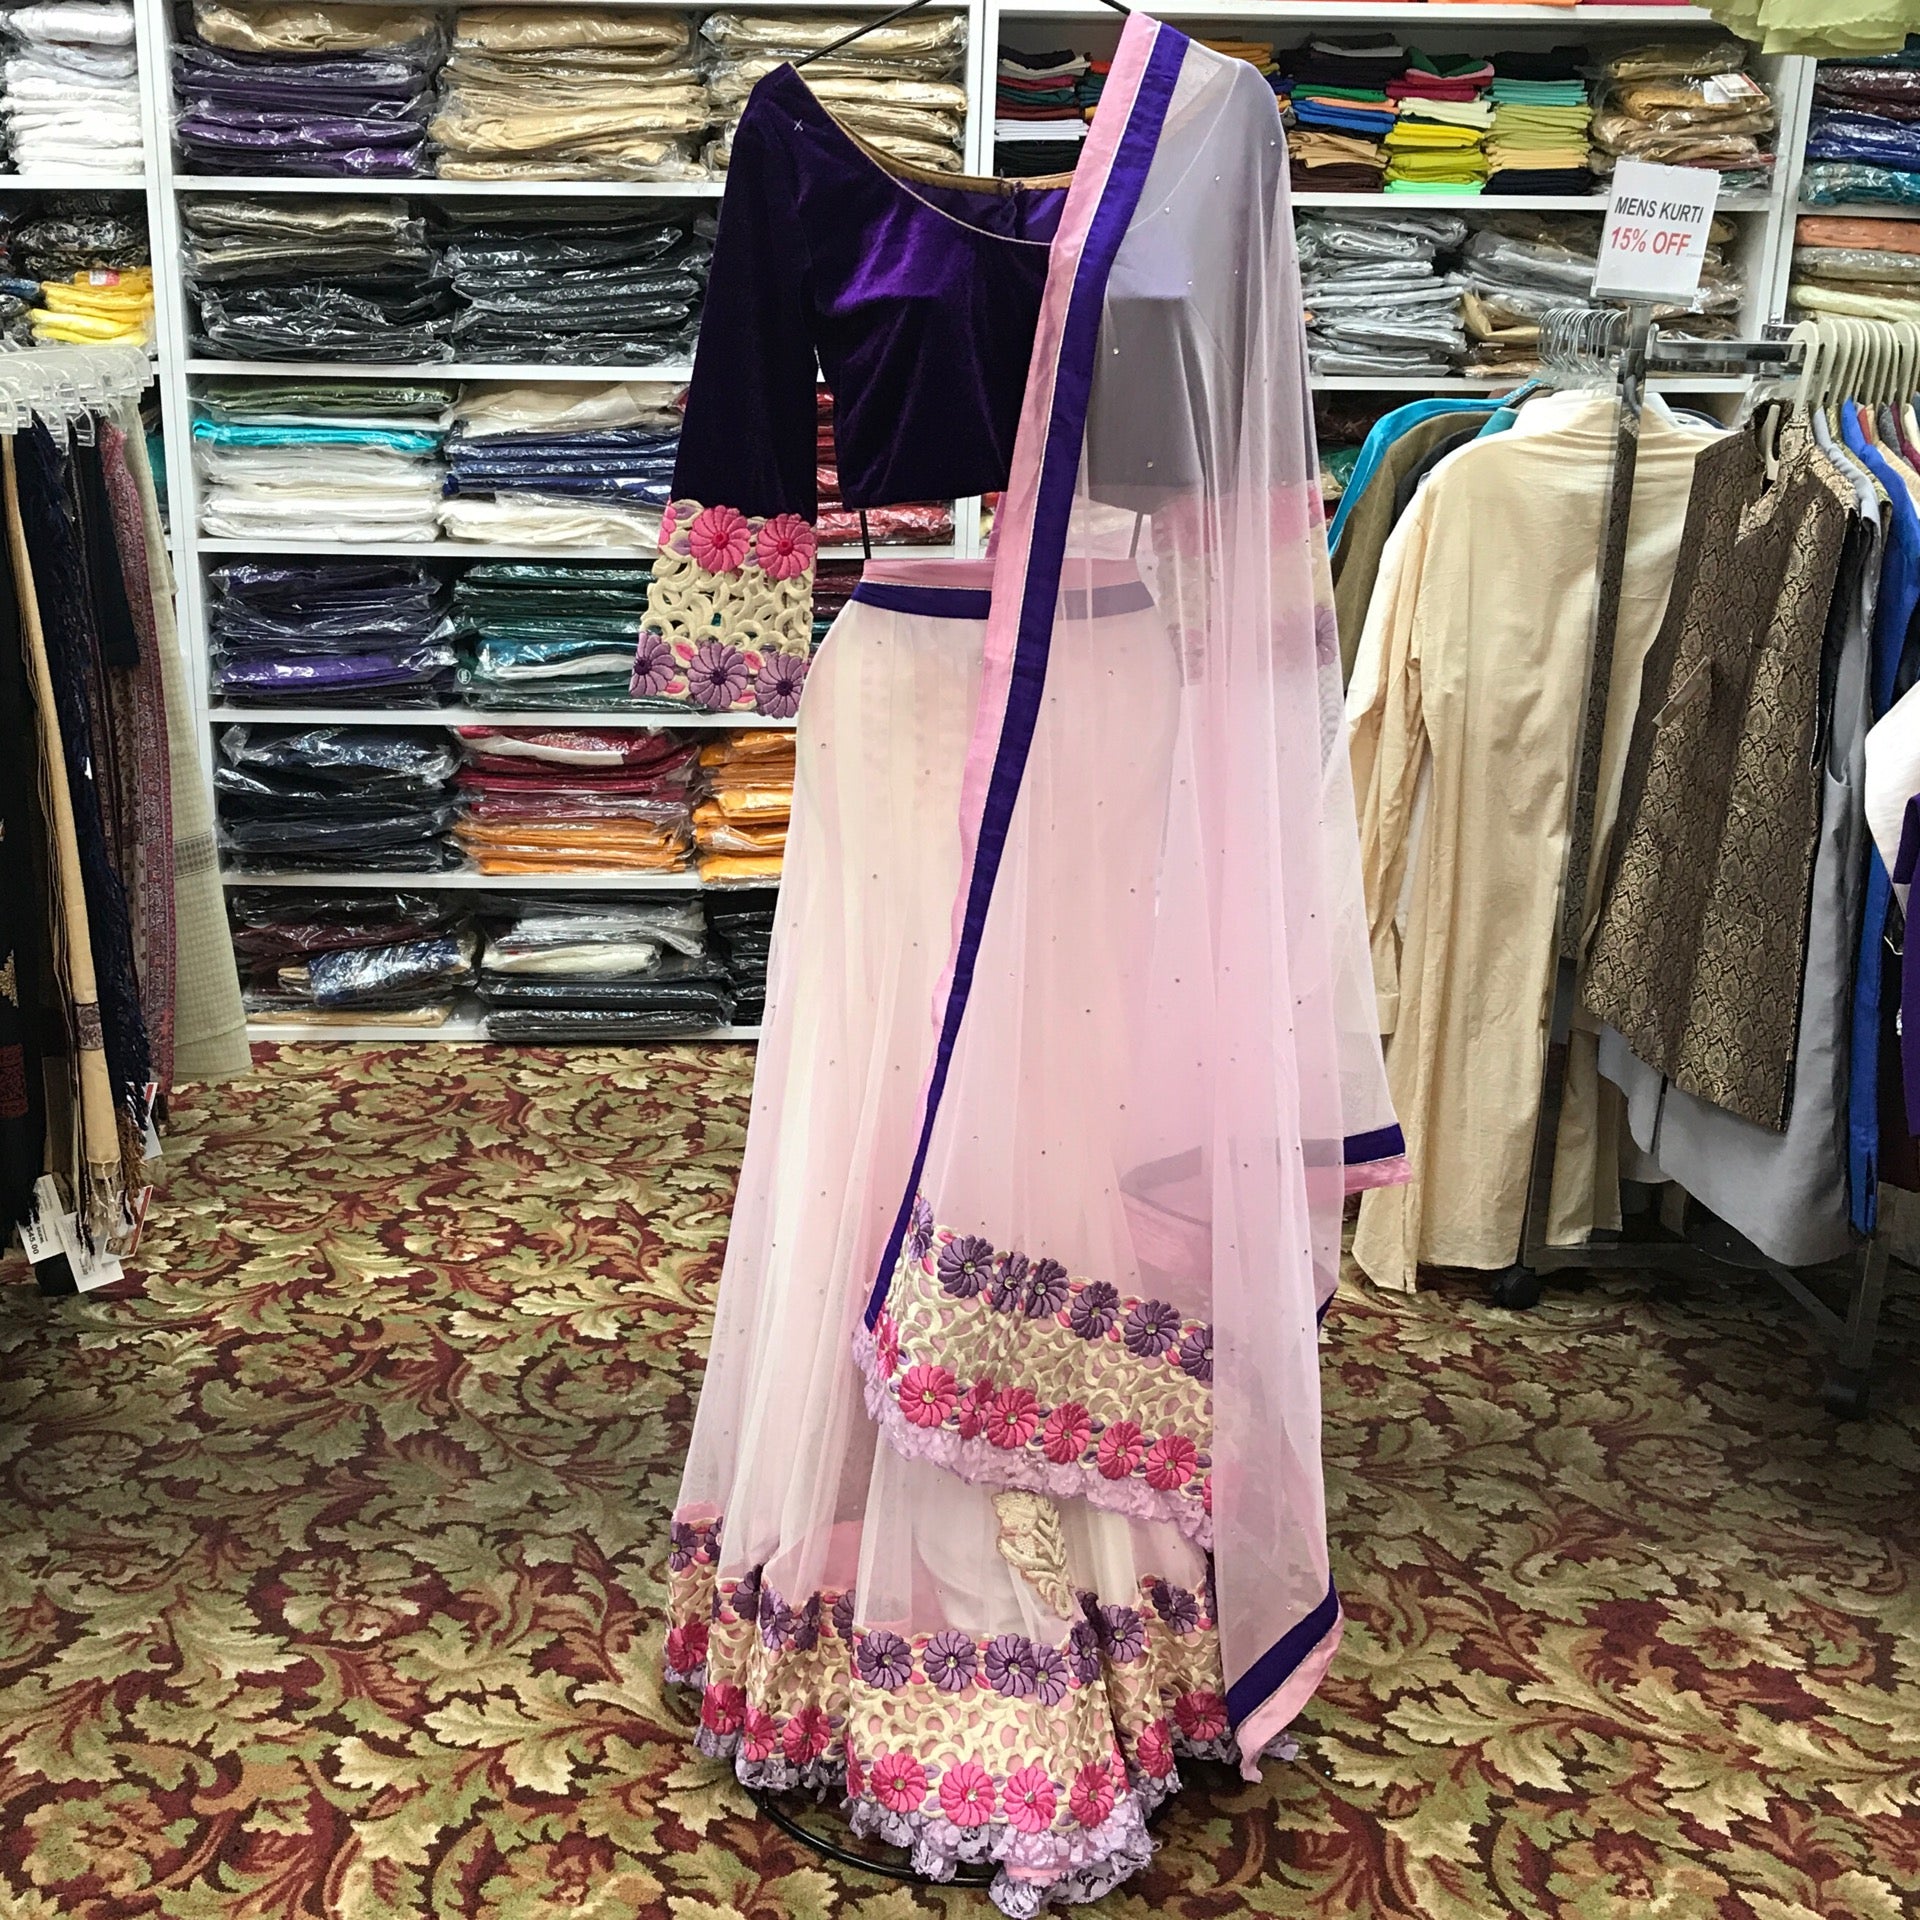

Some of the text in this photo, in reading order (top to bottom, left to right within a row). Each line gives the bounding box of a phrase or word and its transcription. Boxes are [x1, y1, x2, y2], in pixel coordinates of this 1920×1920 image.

[1615, 197, 1704, 223] MENS KURTI
[1612, 227, 1692, 256] 15% OFF
